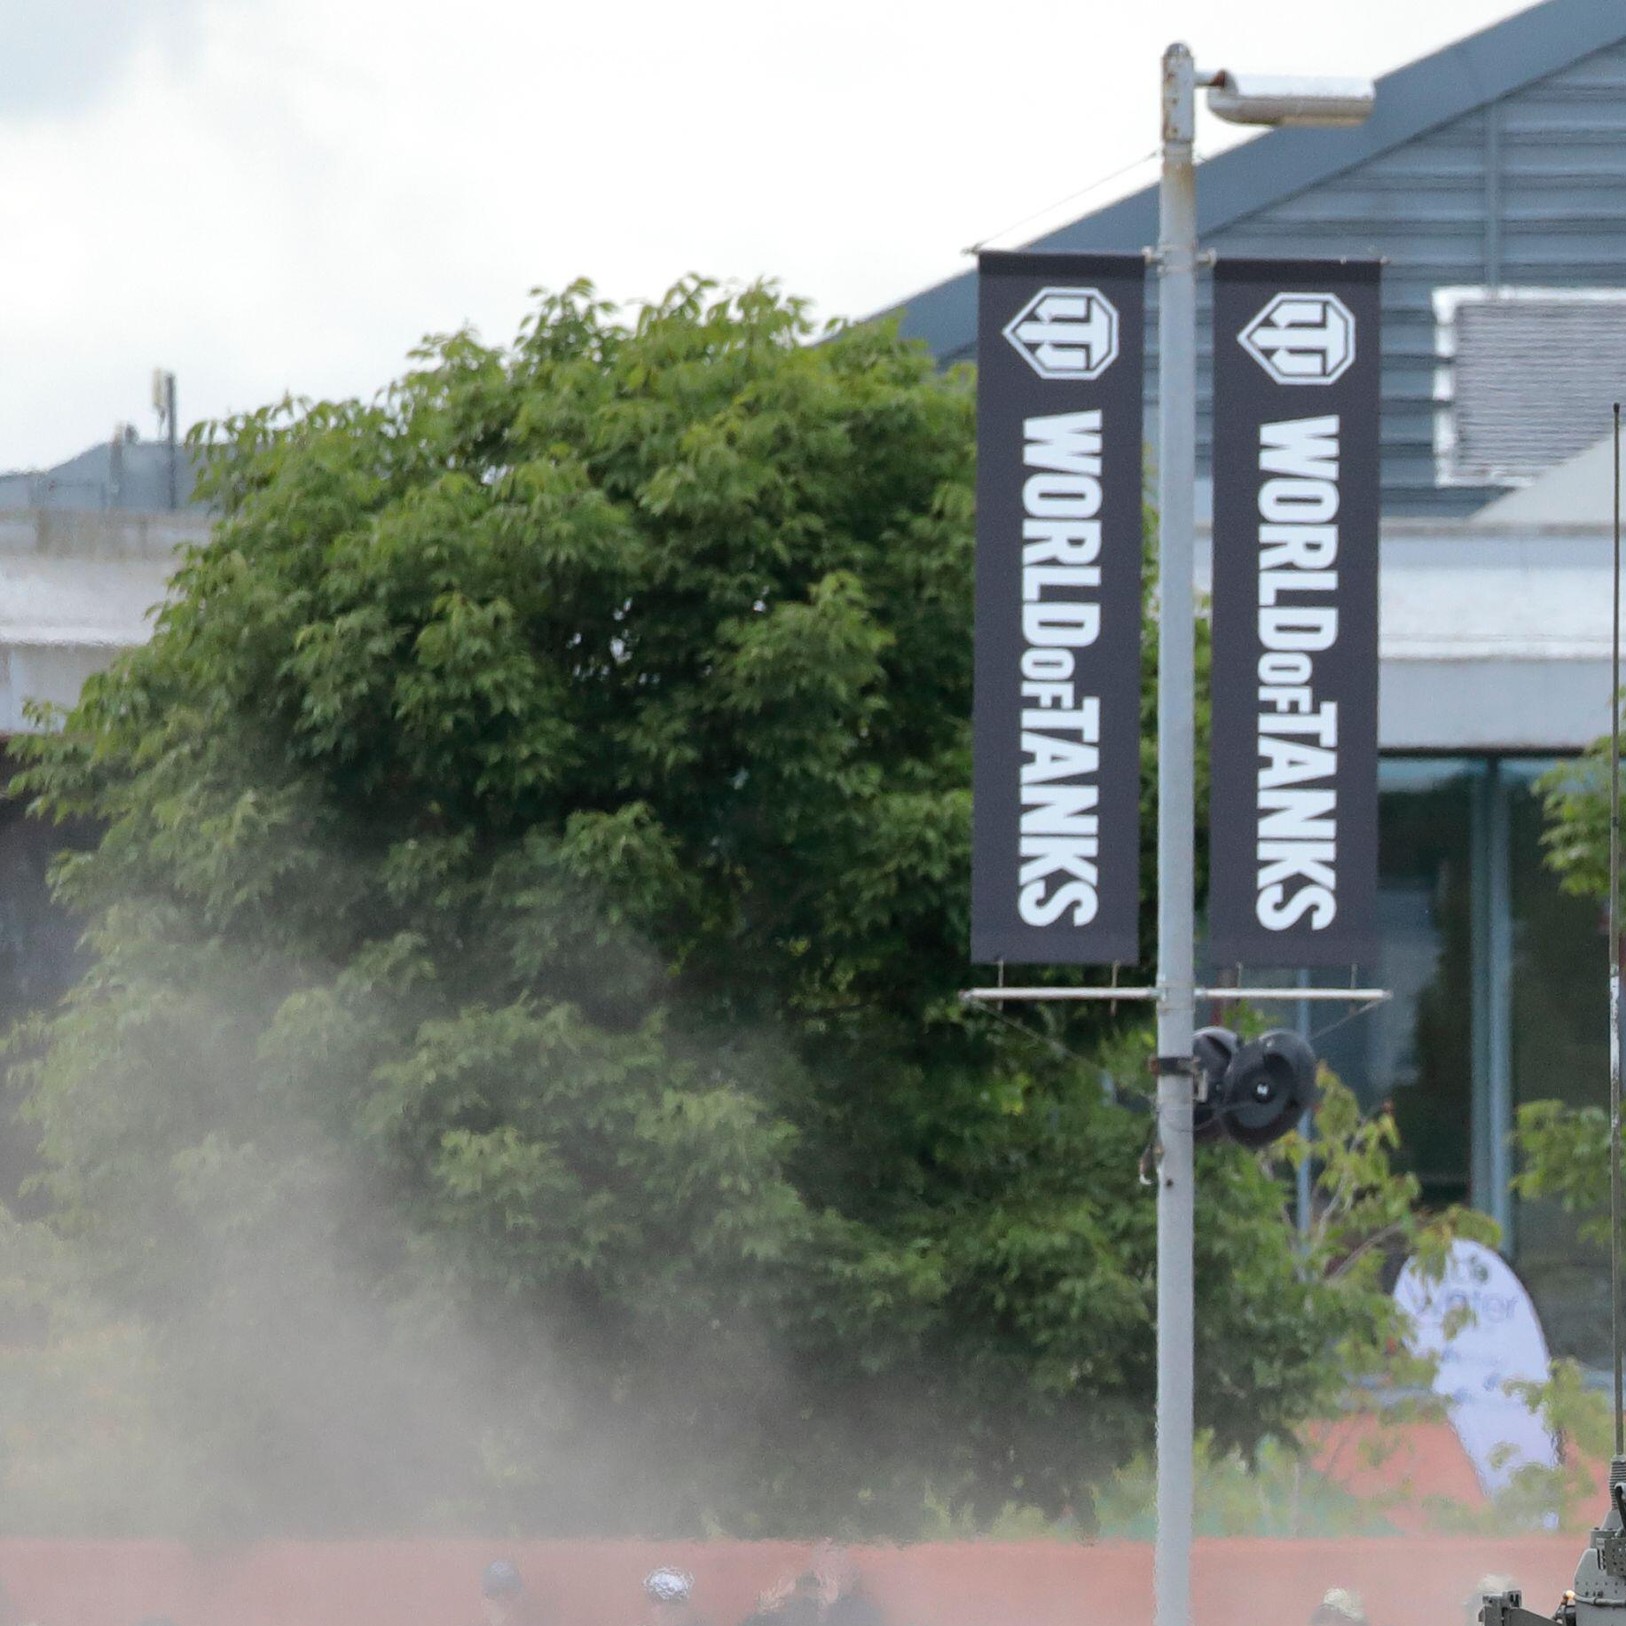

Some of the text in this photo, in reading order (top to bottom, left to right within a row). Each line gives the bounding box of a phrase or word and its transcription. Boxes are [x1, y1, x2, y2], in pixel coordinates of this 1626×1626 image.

[1022, 409, 1103, 648] WORLD
[1257, 414, 1340, 651] WORLD
[1017, 696, 1100, 928] TANKS
[1256, 701, 1338, 931] TANKS
